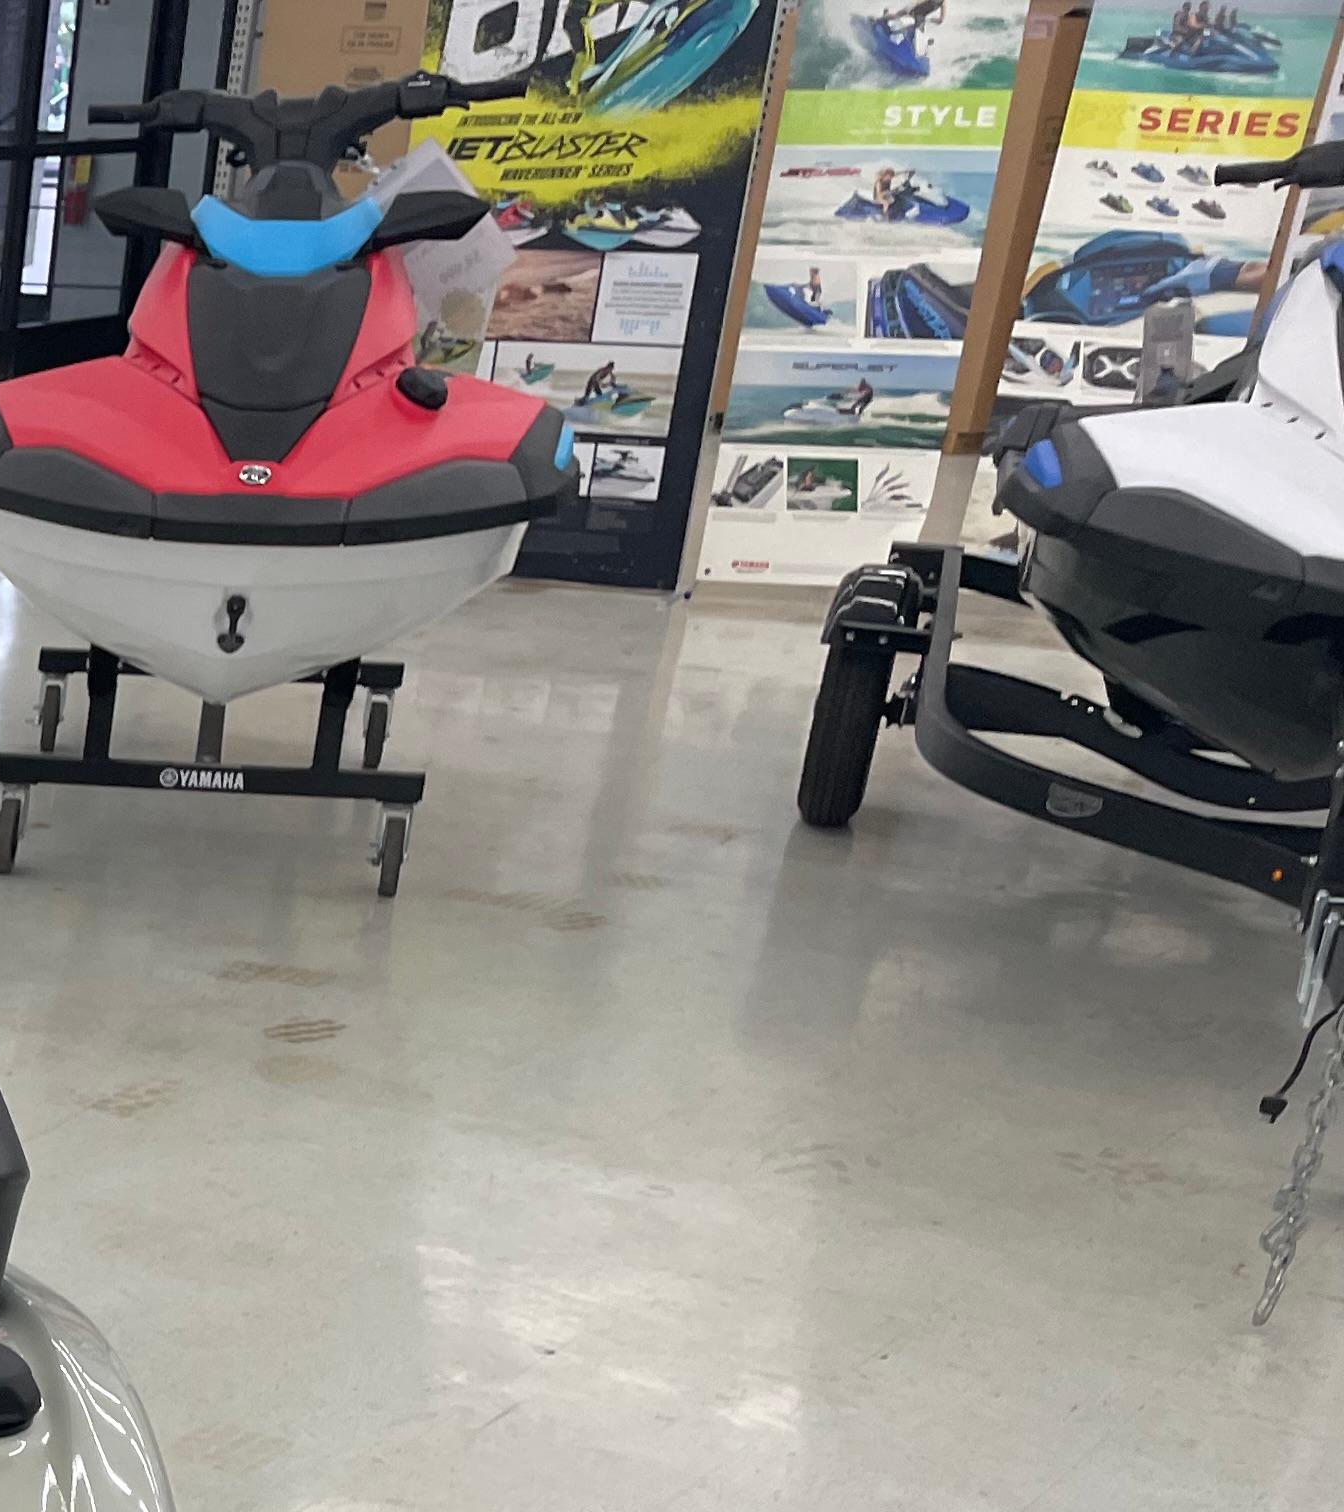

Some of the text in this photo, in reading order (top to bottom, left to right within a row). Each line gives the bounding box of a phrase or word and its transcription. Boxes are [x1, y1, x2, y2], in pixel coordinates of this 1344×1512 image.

[883, 105, 997, 129] STYLE
[1138, 106, 1301, 138] SERIES
[179, 769, 244, 791] YAMAHA
